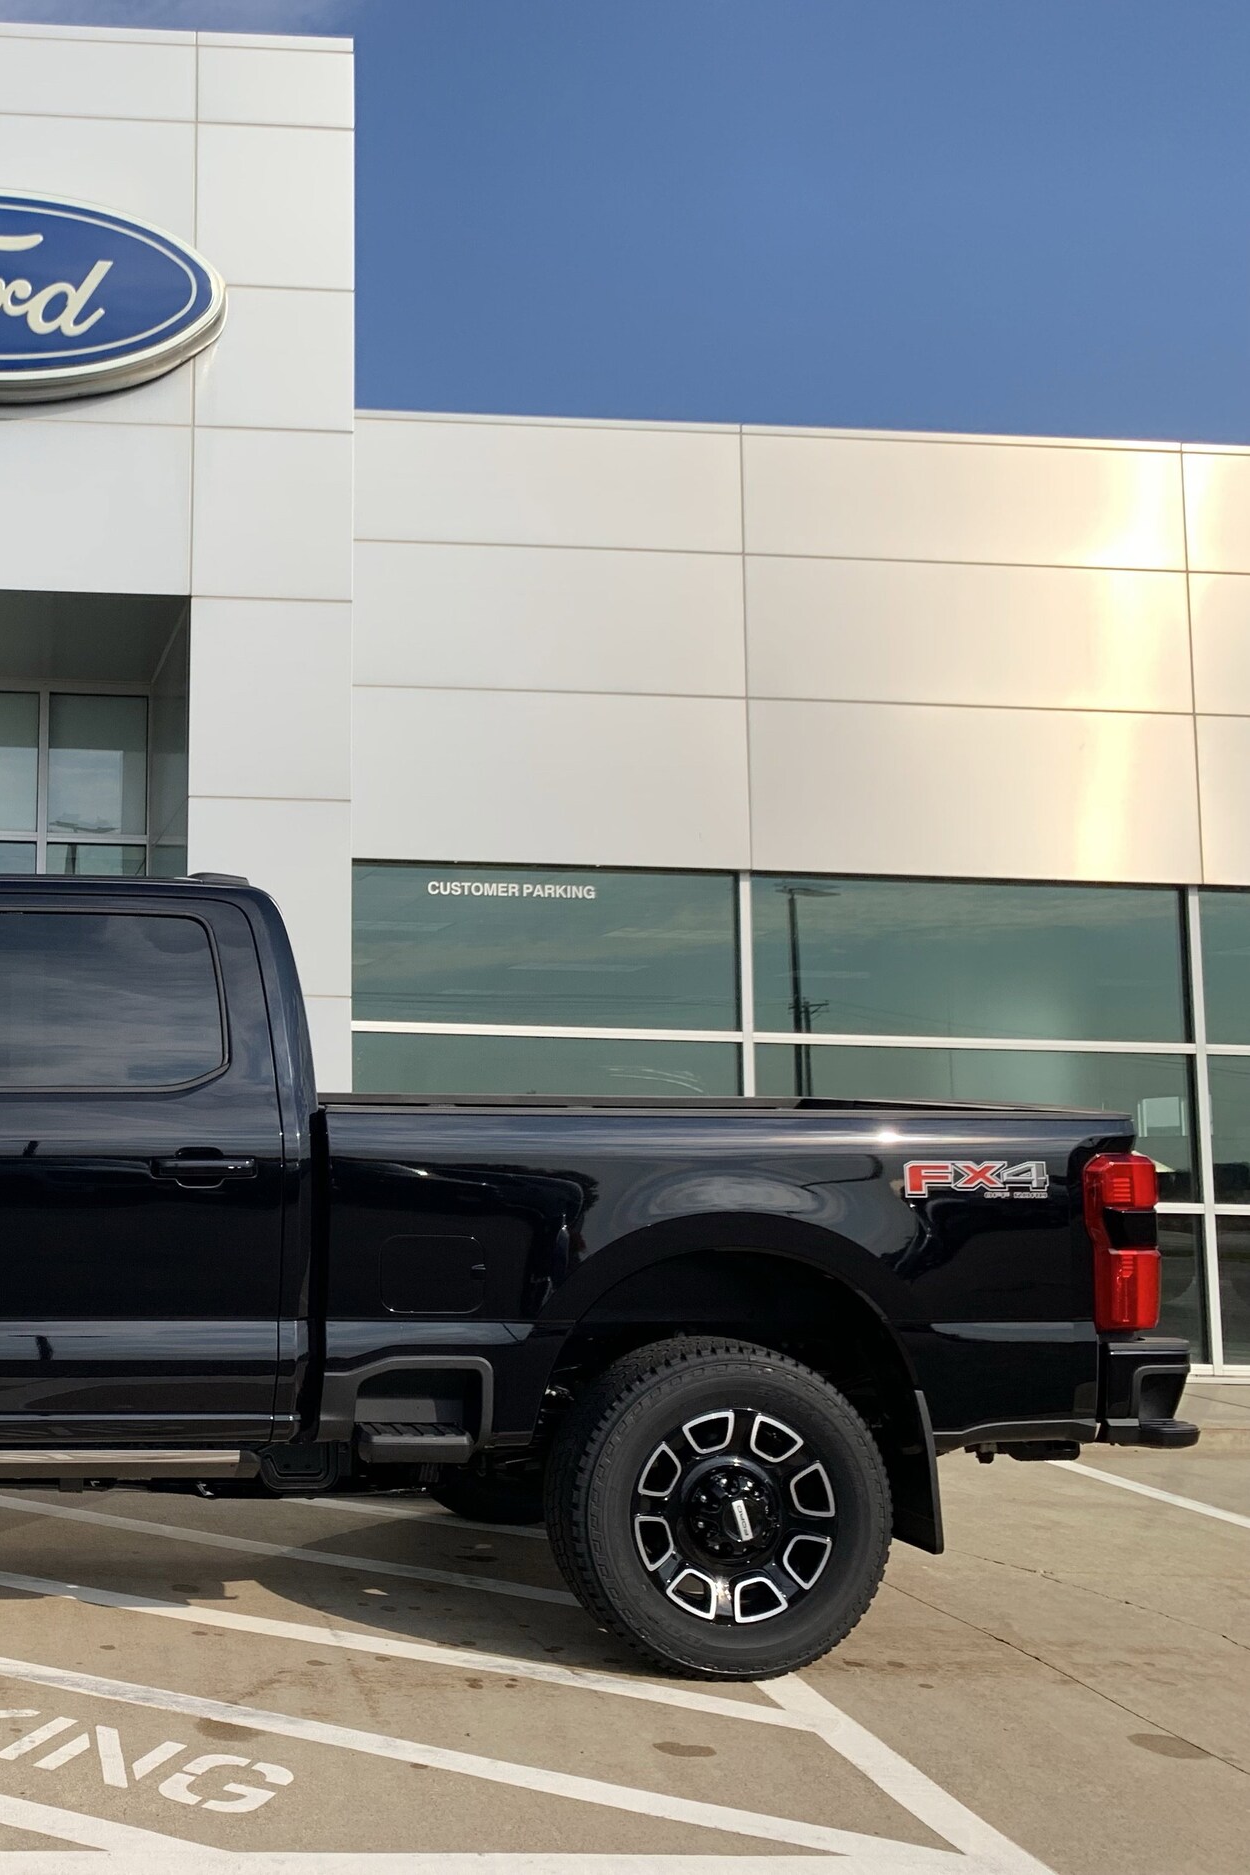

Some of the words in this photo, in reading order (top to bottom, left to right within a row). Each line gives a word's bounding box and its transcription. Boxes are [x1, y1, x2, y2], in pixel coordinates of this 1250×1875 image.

[427, 881, 519, 897] CUSTOMER
[523, 884, 596, 899] PARKING
[903, 1160, 1049, 1198] FX4
